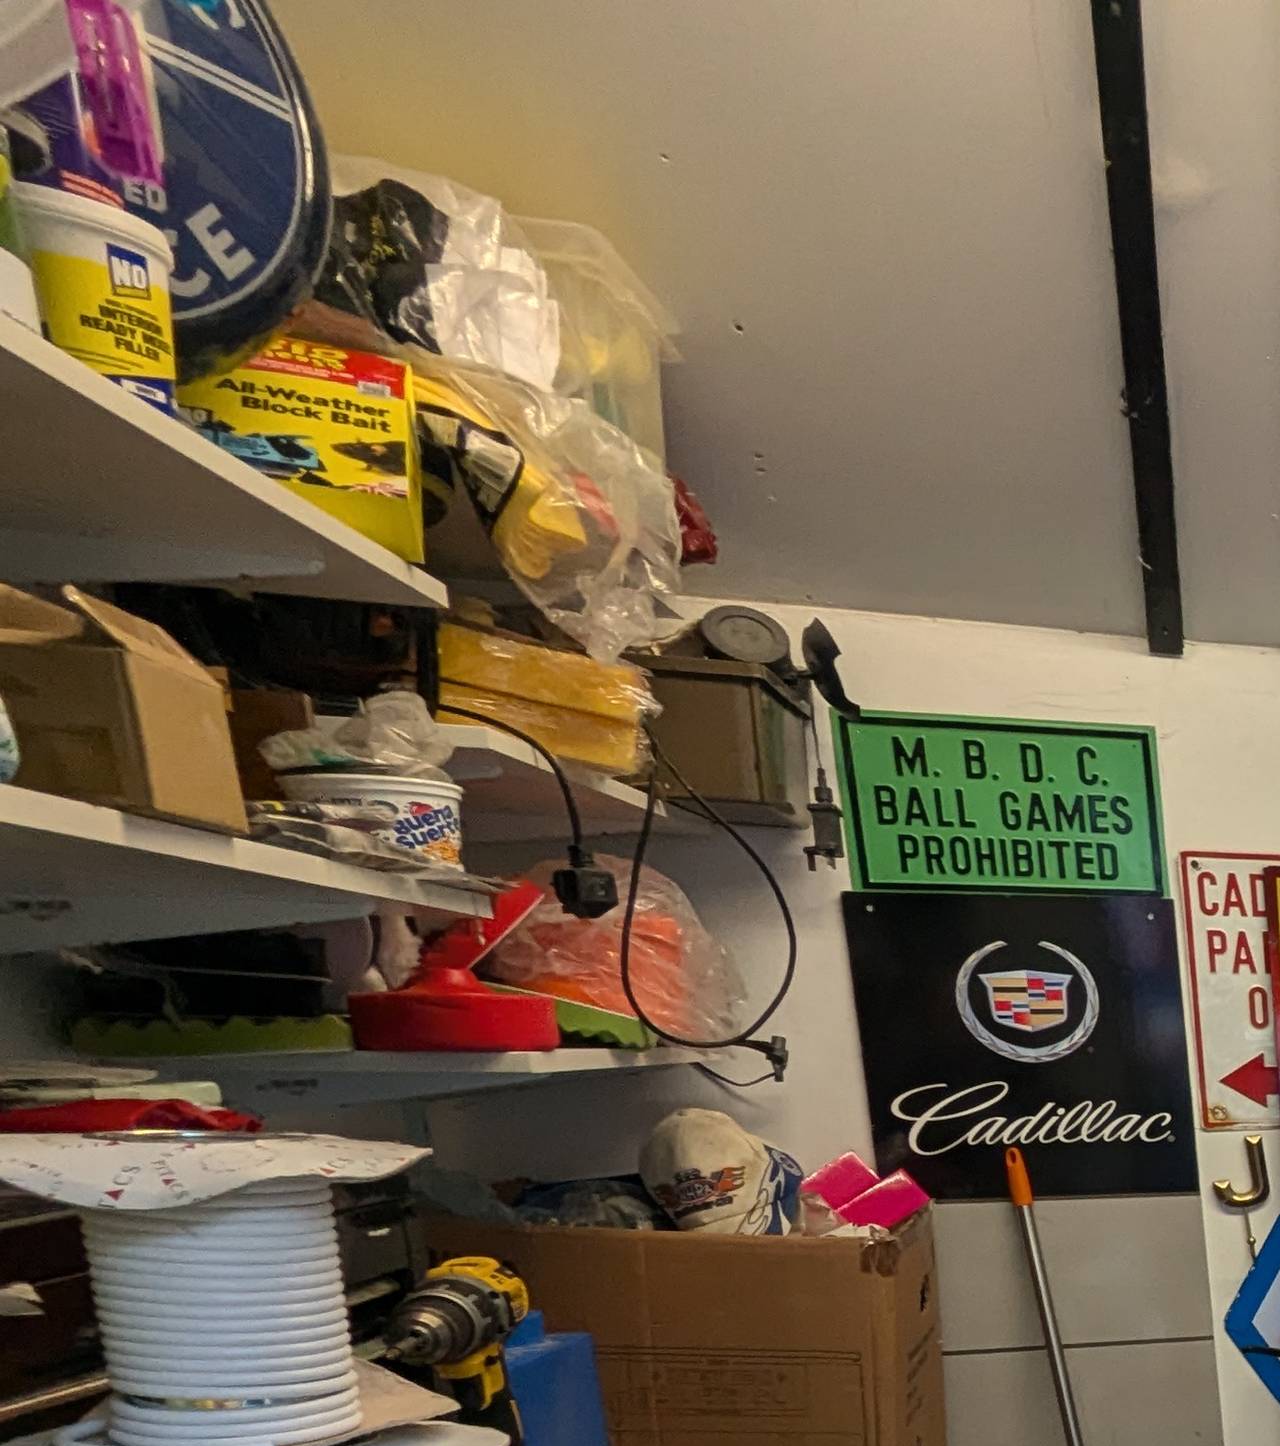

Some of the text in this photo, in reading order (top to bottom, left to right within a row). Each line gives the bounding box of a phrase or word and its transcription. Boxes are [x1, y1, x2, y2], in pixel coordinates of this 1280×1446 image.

[111, 254, 149, 289] NO
[79, 314, 137, 340] READY
[215, 378, 392, 418] All-Weather
[240, 395, 392, 433] Block Bait
[873, 784, 1133, 835] BALL GAMES
[899, 834, 1120, 881] PROHIBITED
[890, 1080, 1172, 1157] Cadillac
